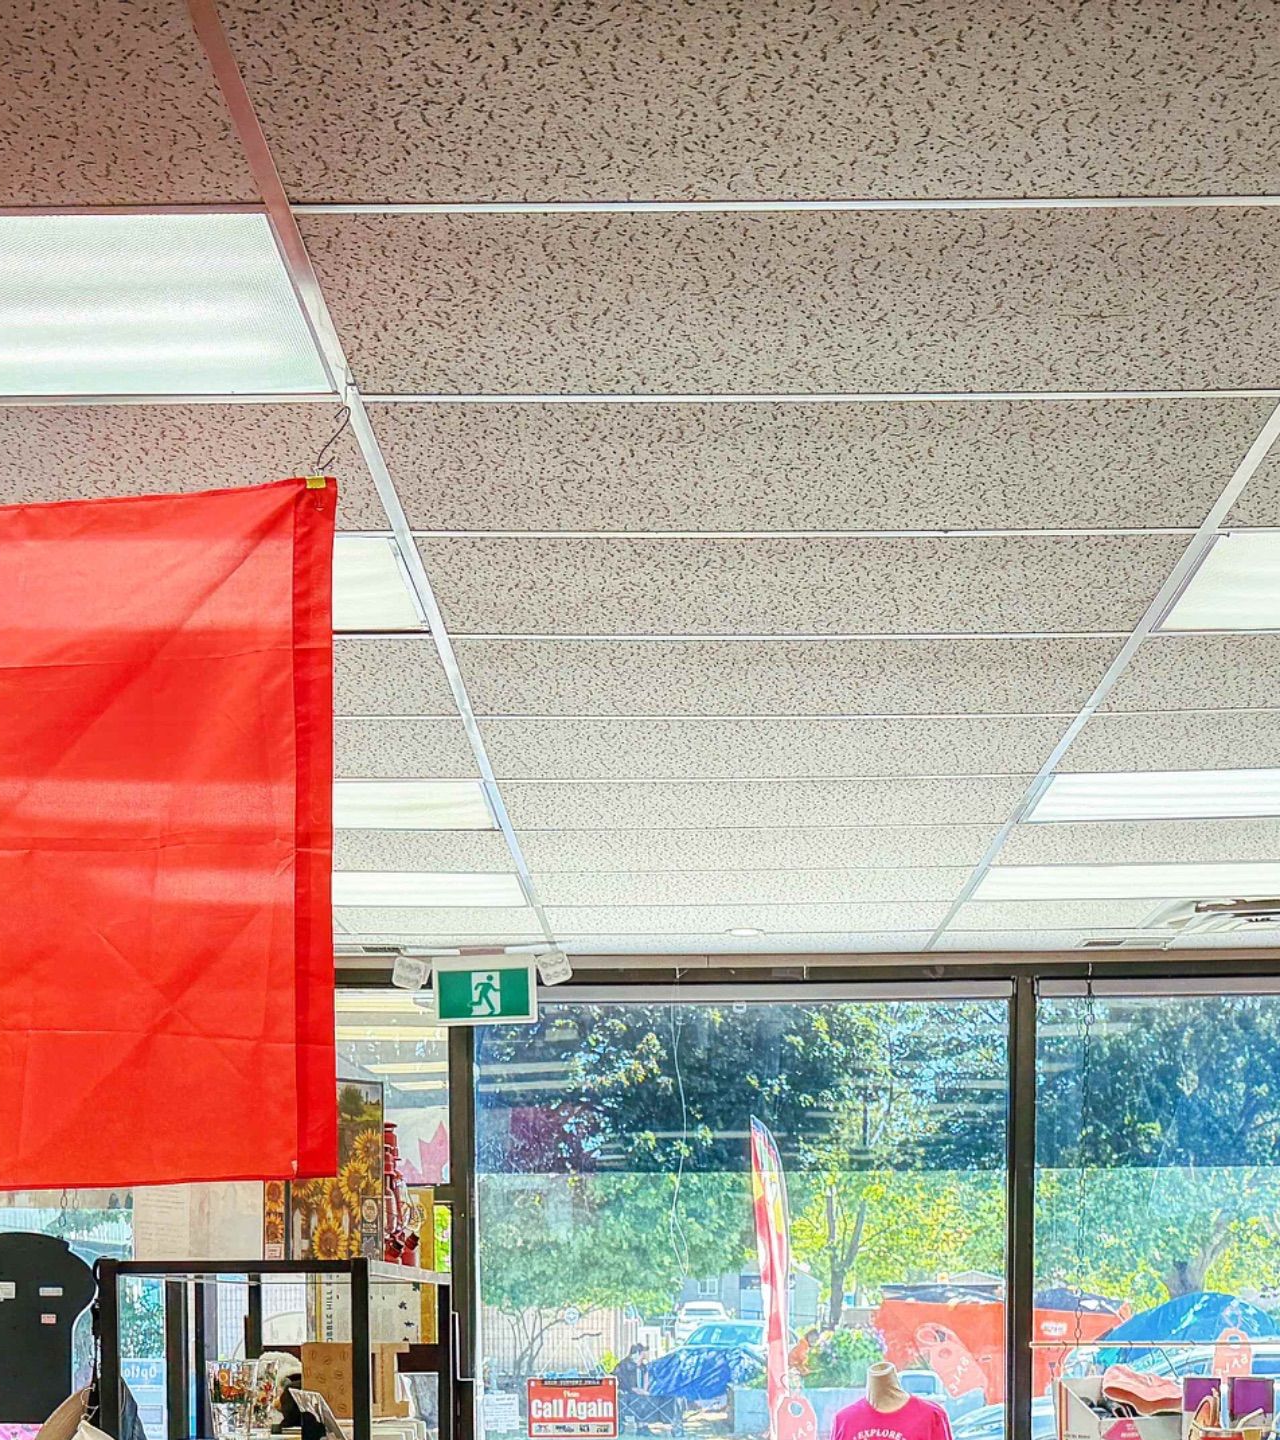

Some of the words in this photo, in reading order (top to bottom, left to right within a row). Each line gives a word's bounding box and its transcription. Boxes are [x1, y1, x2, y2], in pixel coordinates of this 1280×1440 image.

[531, 1399, 564, 1419] Call
[567, 1398, 614, 1421] Again
[858, 1428, 903, 1440] EXPLORE
